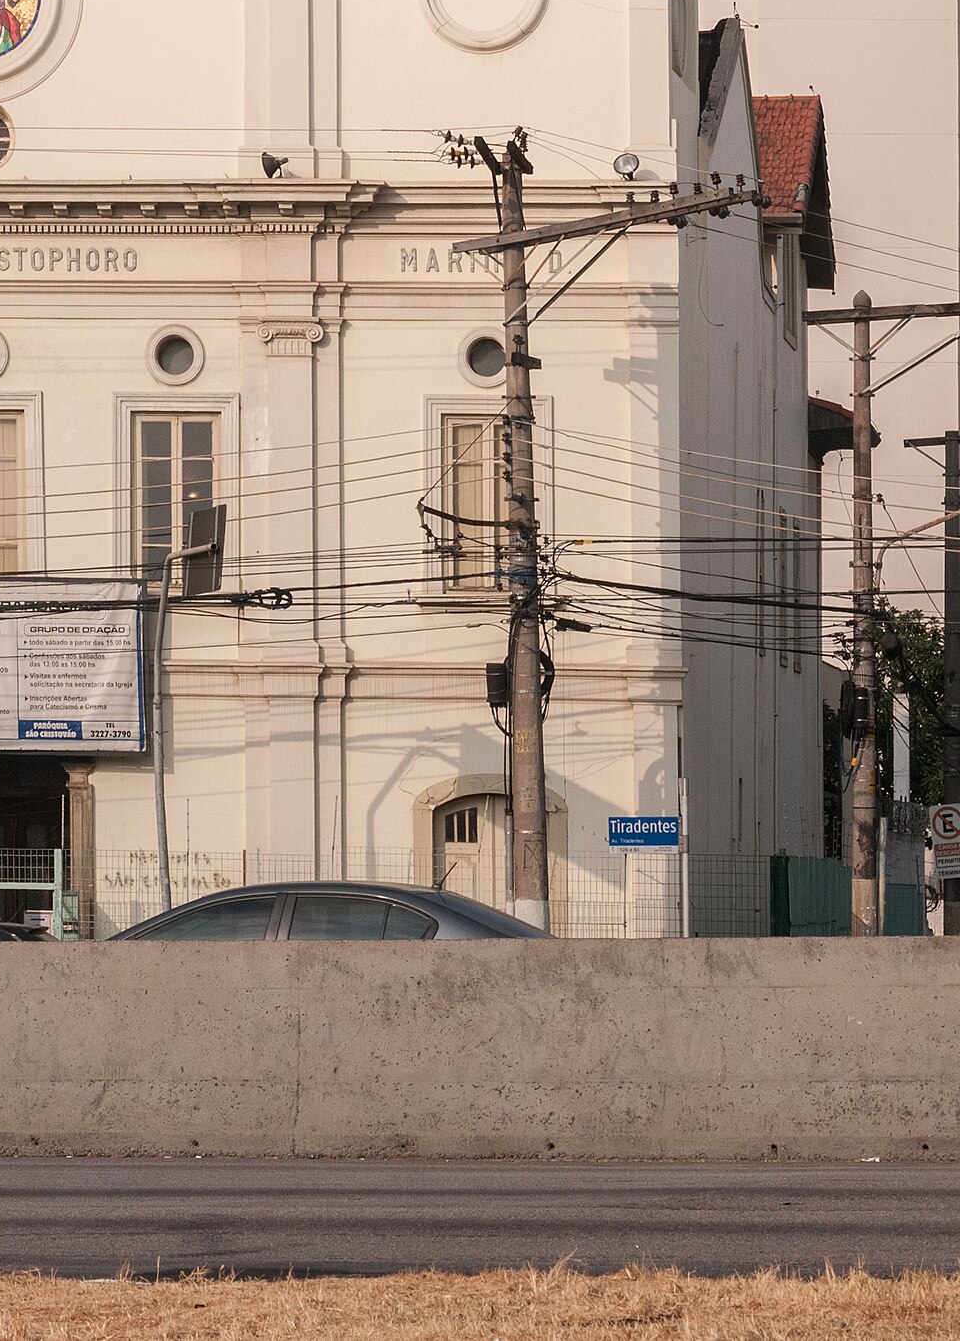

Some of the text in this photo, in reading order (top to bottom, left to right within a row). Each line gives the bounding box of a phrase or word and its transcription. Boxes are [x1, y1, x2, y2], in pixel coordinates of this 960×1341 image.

[30, 626, 65, 634] GRUPO
[67, 626, 80, 634] DE
[124, 639, 132, 647] hs
[29, 681, 63, 689] solicitação
[115, 681, 133, 689] Igreja
[29, 695, 62, 703] Inscrições
[45, 703, 78, 711] Catecismo
[84, 703, 107, 711] Crisma
[33, 720, 68, 730] PARÓQUIA
[26, 729, 76, 738] SÃO CRISTOVÃO
[610, 819, 677, 833] Tiradentes
